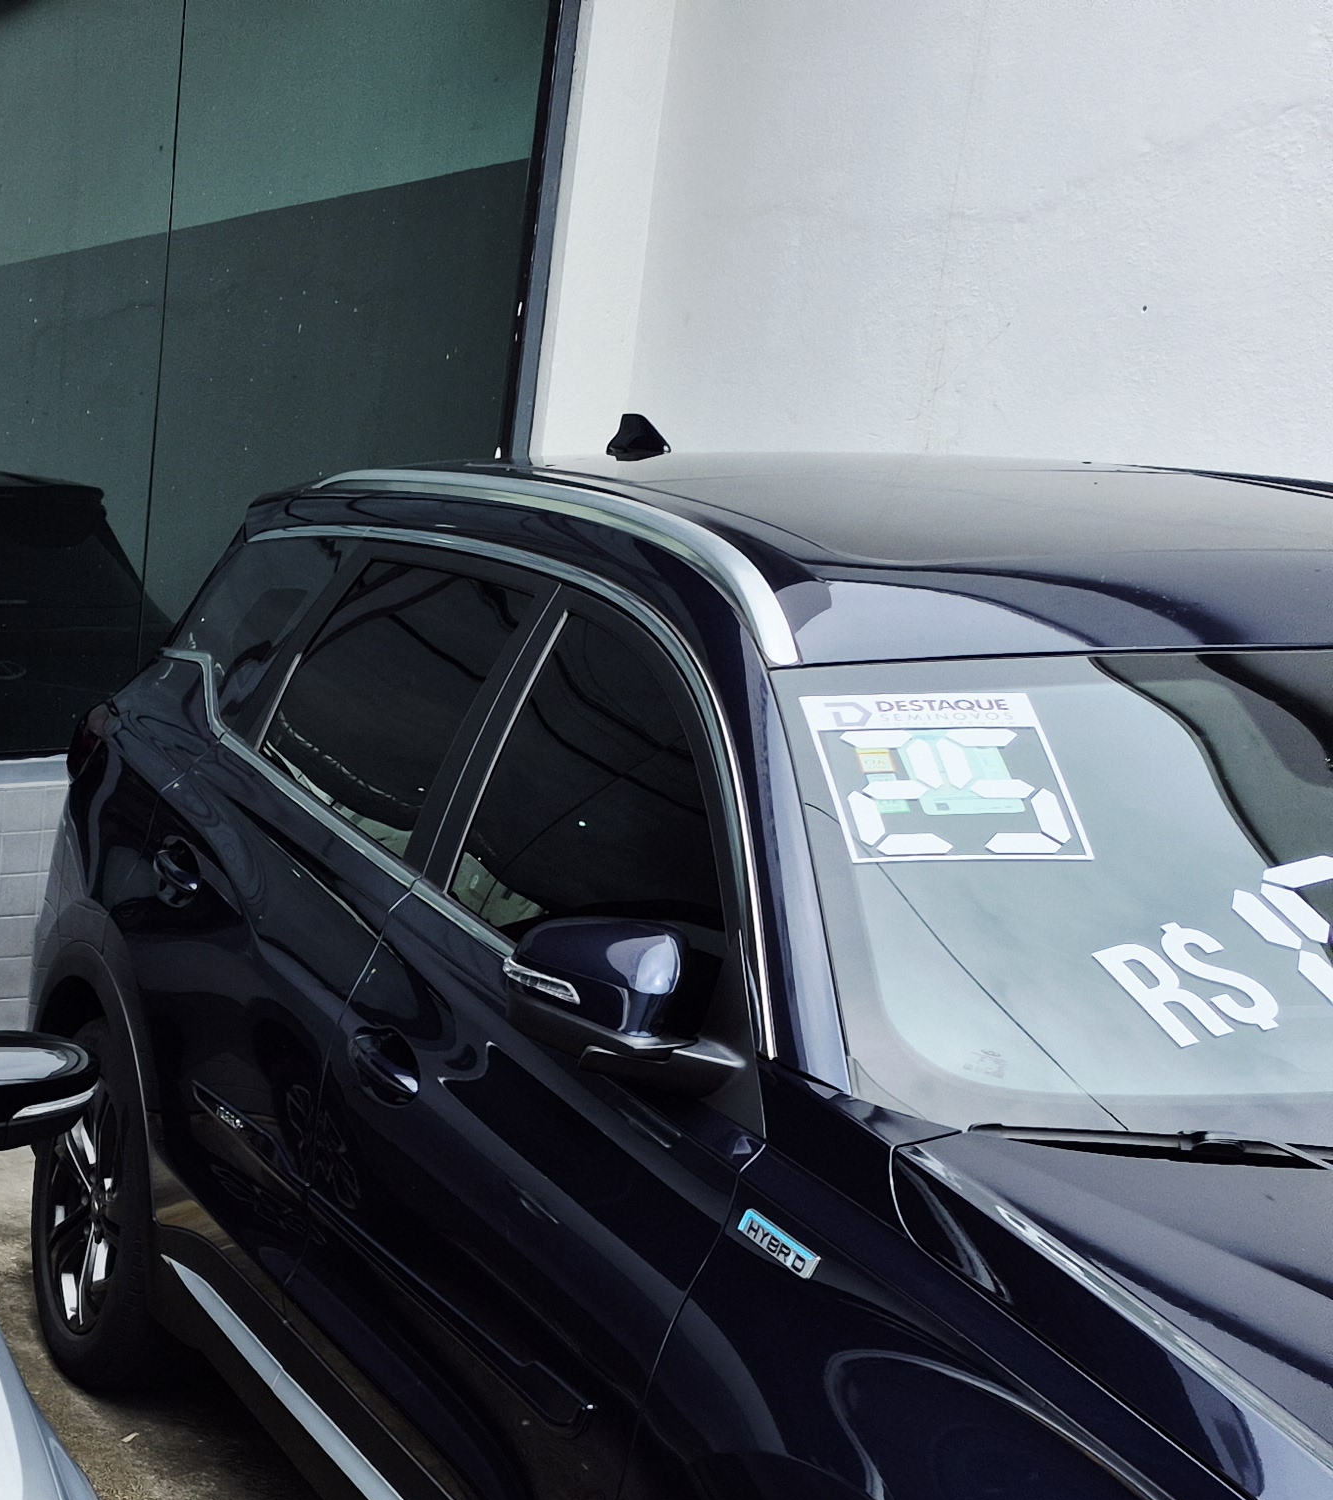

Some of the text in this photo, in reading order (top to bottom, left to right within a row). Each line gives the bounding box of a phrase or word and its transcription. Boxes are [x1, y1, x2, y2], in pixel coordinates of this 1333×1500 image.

[875, 699, 1010, 712] DESTAQUE
[879, 712, 1014, 721] SEMINOVOS
[1091, 921, 1280, 1048] R$
[746, 1220, 806, 1273] HYBRD
